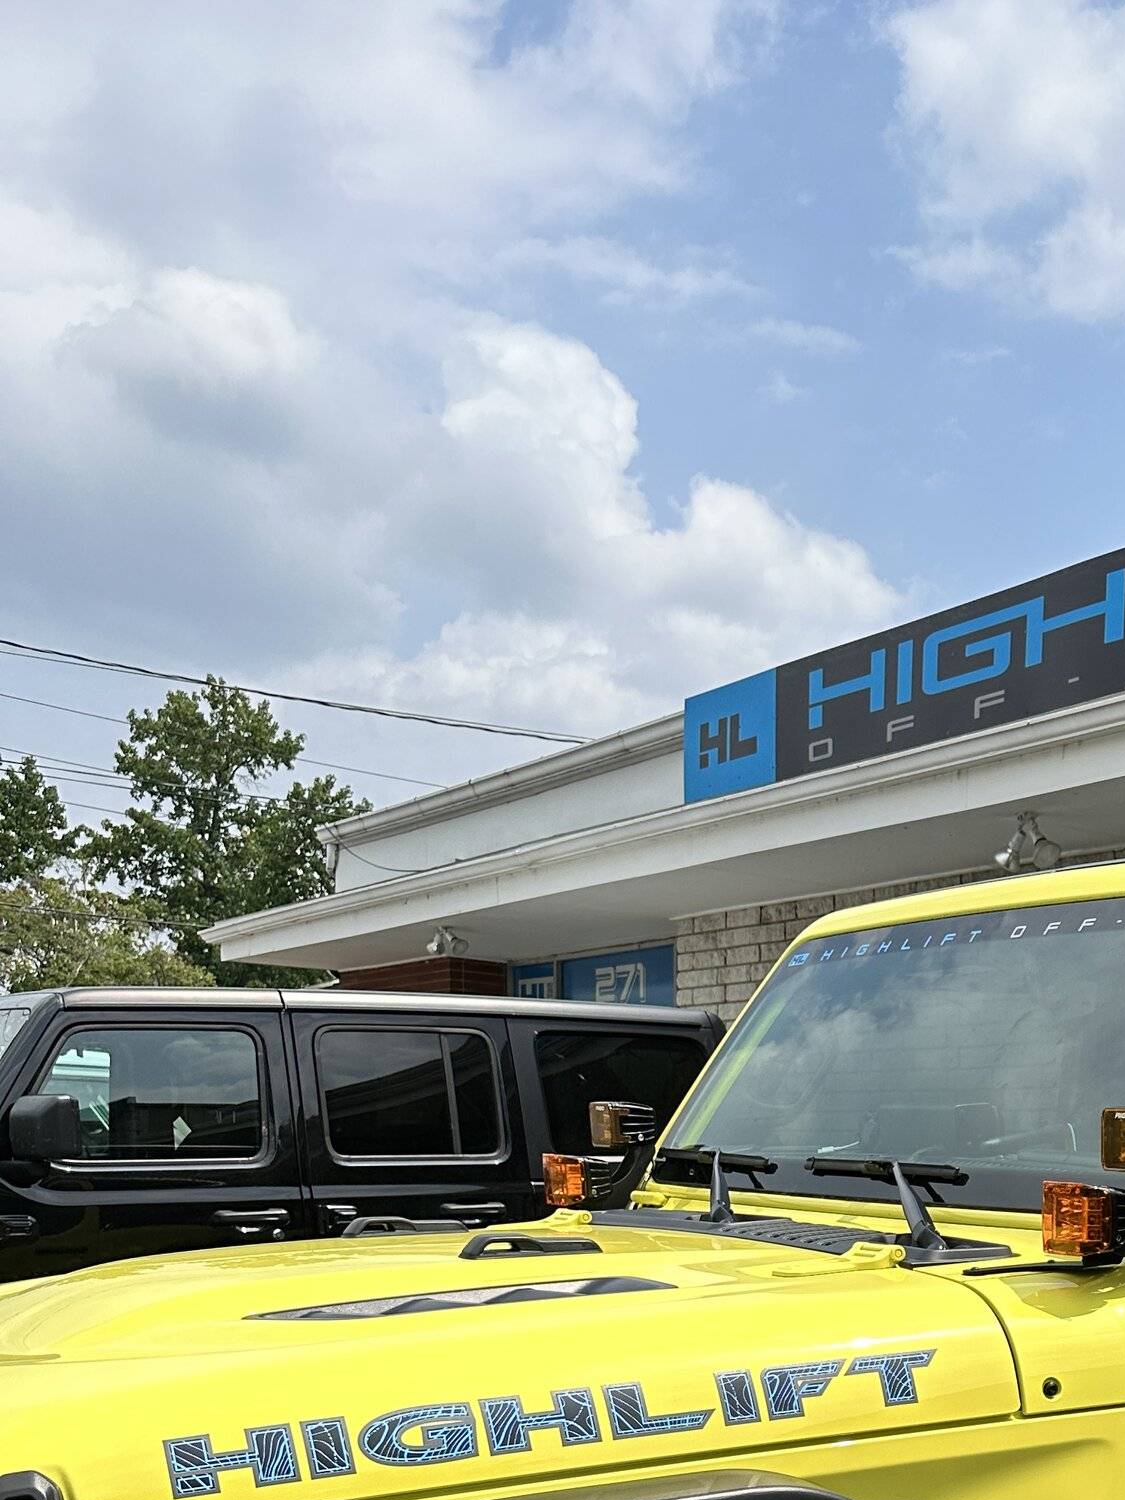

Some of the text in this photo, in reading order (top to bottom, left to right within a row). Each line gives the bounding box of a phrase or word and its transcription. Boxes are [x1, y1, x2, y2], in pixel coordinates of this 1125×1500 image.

[699, 713, 758, 769] HL
[820, 928, 983, 962] HIGHLIFT
[595, 963, 646, 1003] 271
[163, 1348, 939, 1499] HIGHLIFT
